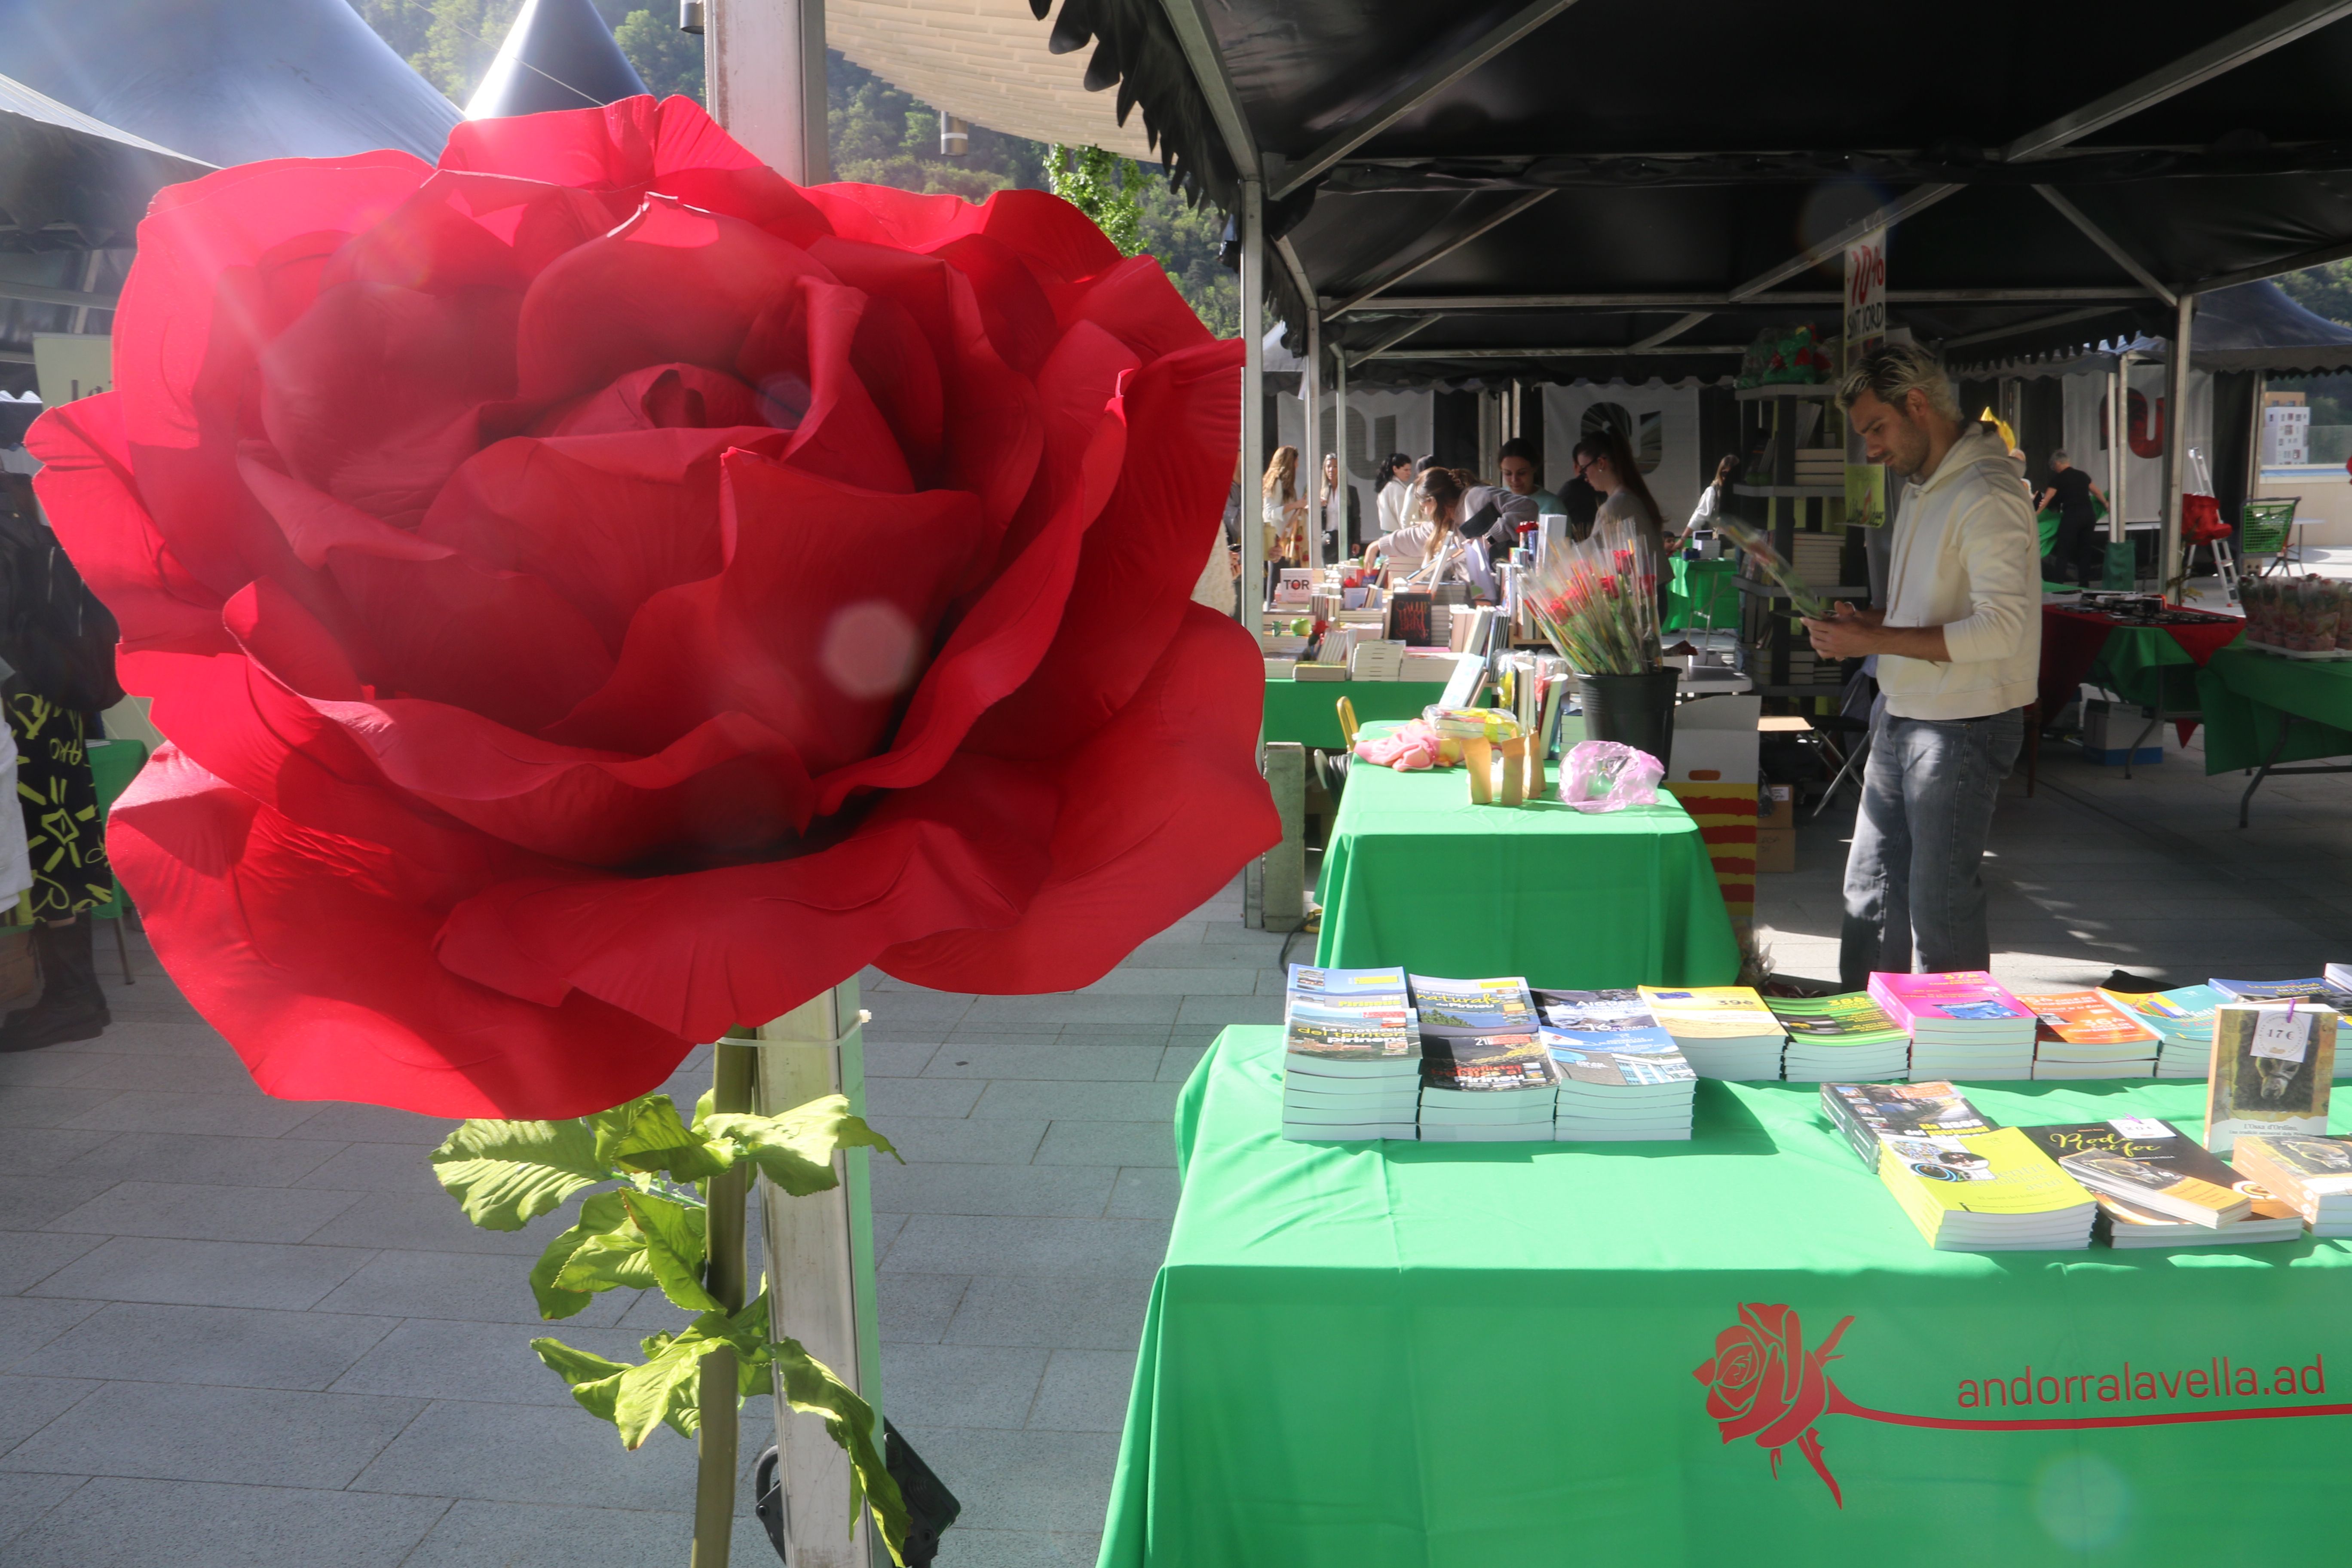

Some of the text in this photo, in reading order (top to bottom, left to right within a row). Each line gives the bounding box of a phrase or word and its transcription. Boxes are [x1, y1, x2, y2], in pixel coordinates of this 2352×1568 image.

[1283, 579, 1310, 590] TOR
[1416, 993, 1500, 1004] naturals
[1298, 1027, 1327, 1036] del
[1454, 1074, 1525, 1083] Pirineu
[1938, 1119, 1984, 1129] usos
[1926, 1125, 1991, 1136] patrimoni
[2025, 1177, 2064, 1191] avui
[1957, 1354, 2326, 1408] andorralavella.ad
